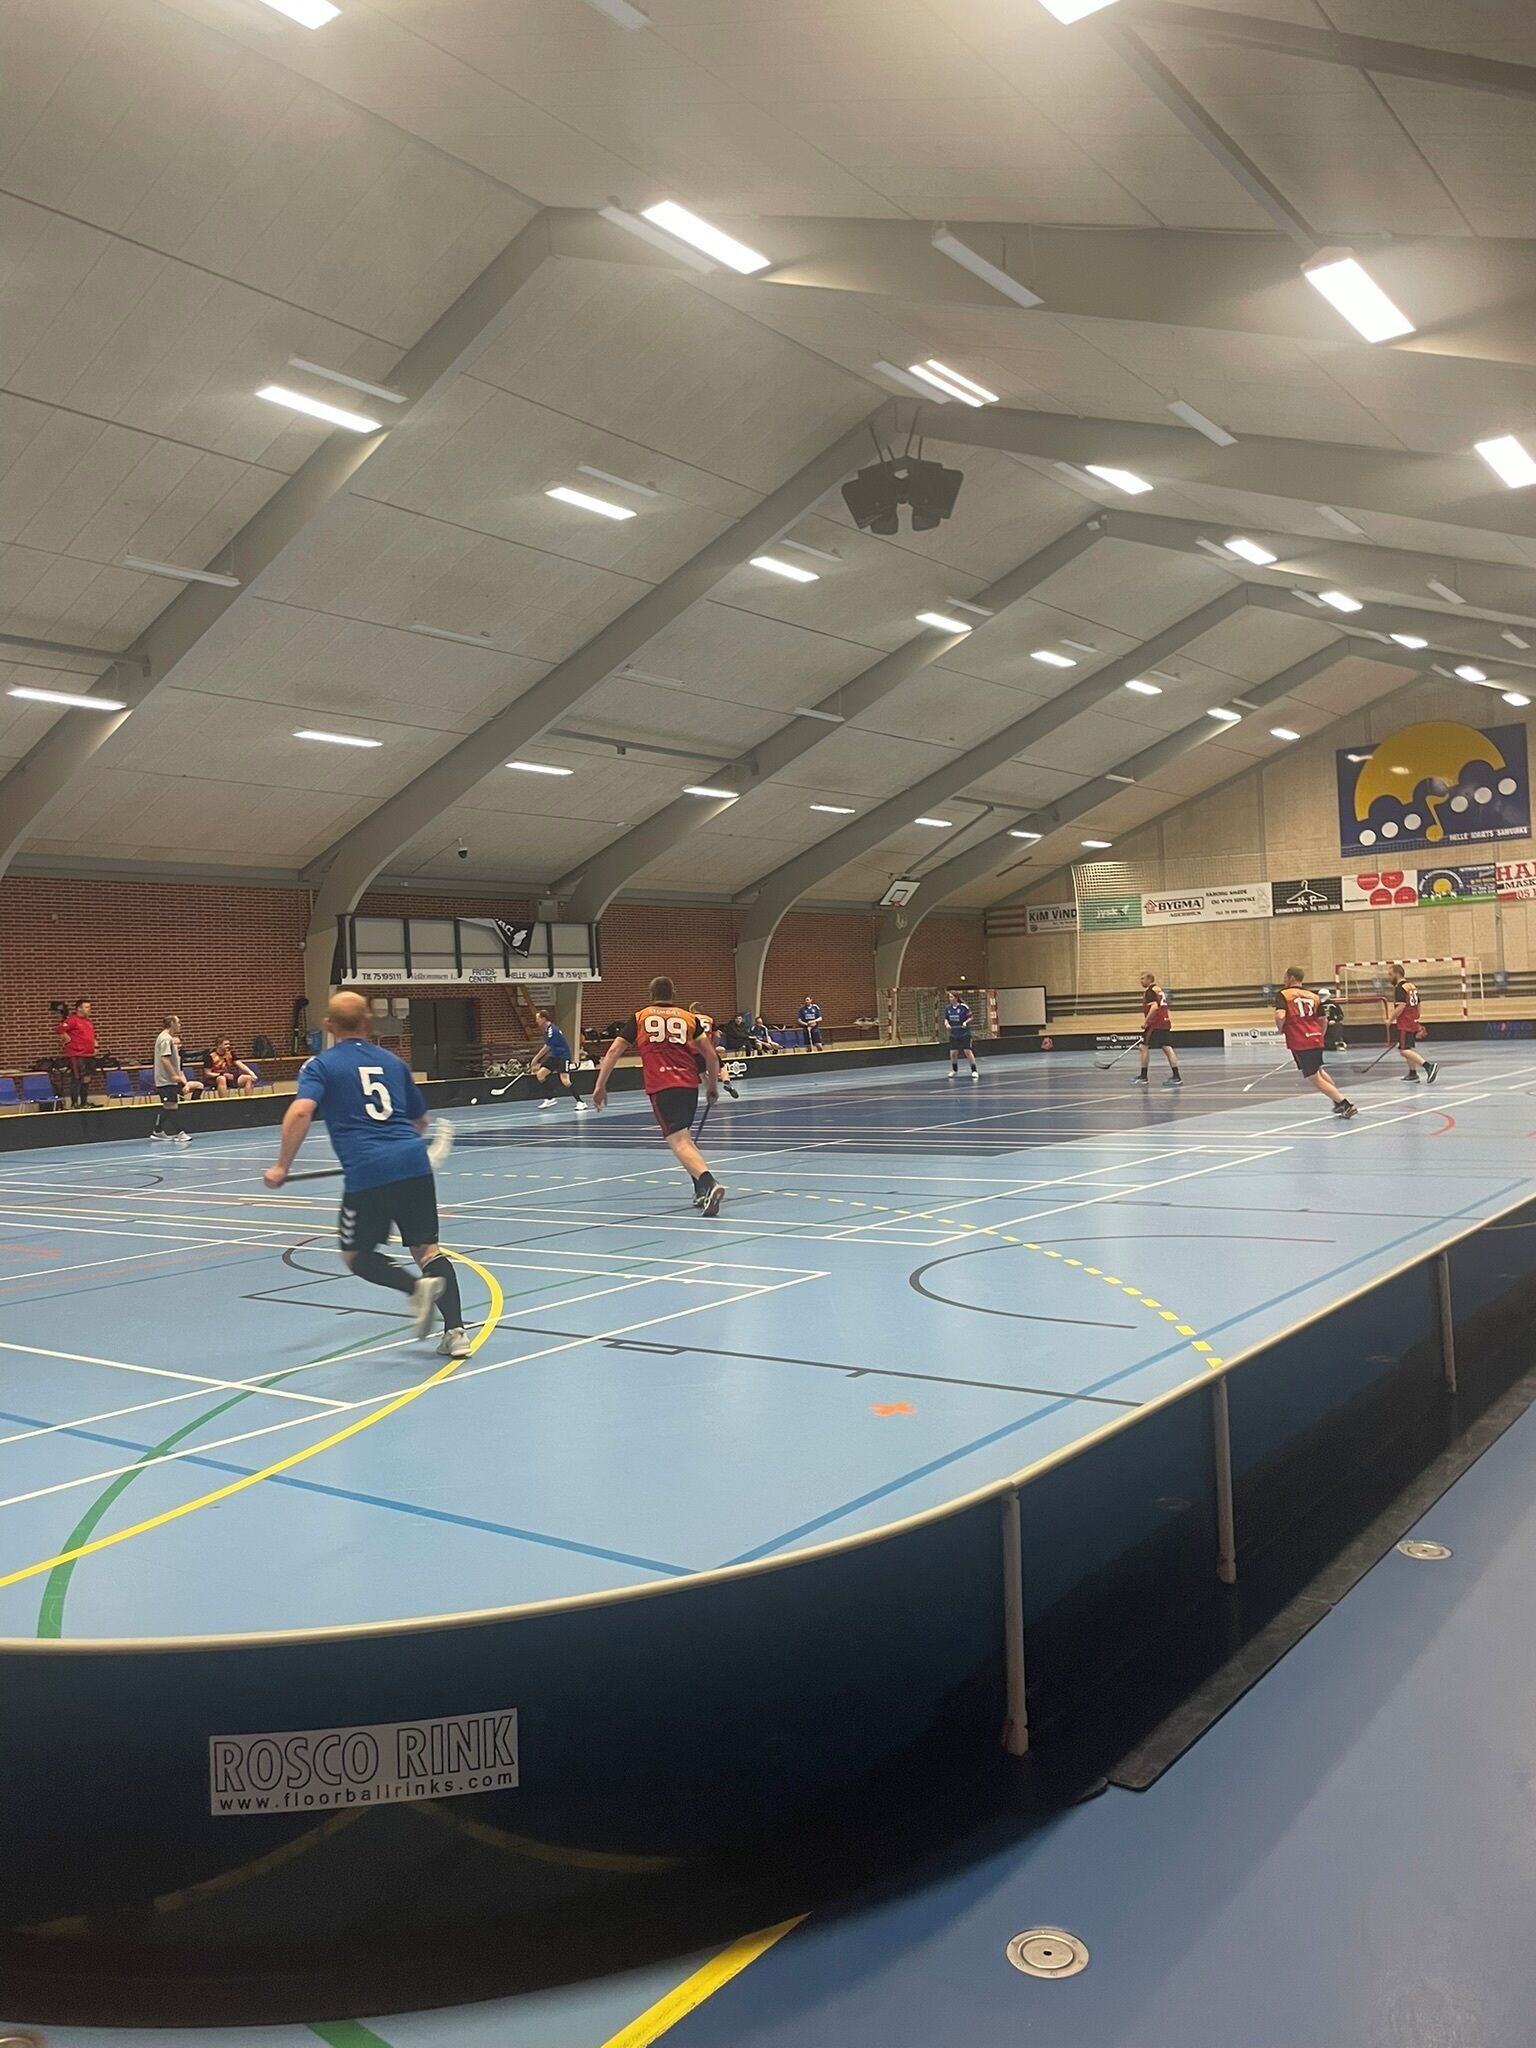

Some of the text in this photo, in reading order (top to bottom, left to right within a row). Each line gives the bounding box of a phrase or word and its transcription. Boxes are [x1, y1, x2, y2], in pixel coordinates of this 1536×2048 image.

[1028, 911, 1049, 922] KIM
[1158, 899, 1201, 911] BYGMA
[644, 1015, 688, 1045] 99
[358, 1066, 393, 1121] 5
[213, 1714, 515, 1793] ROSCO RINK
[219, 1770, 513, 1811] www.floorballrinks.com
